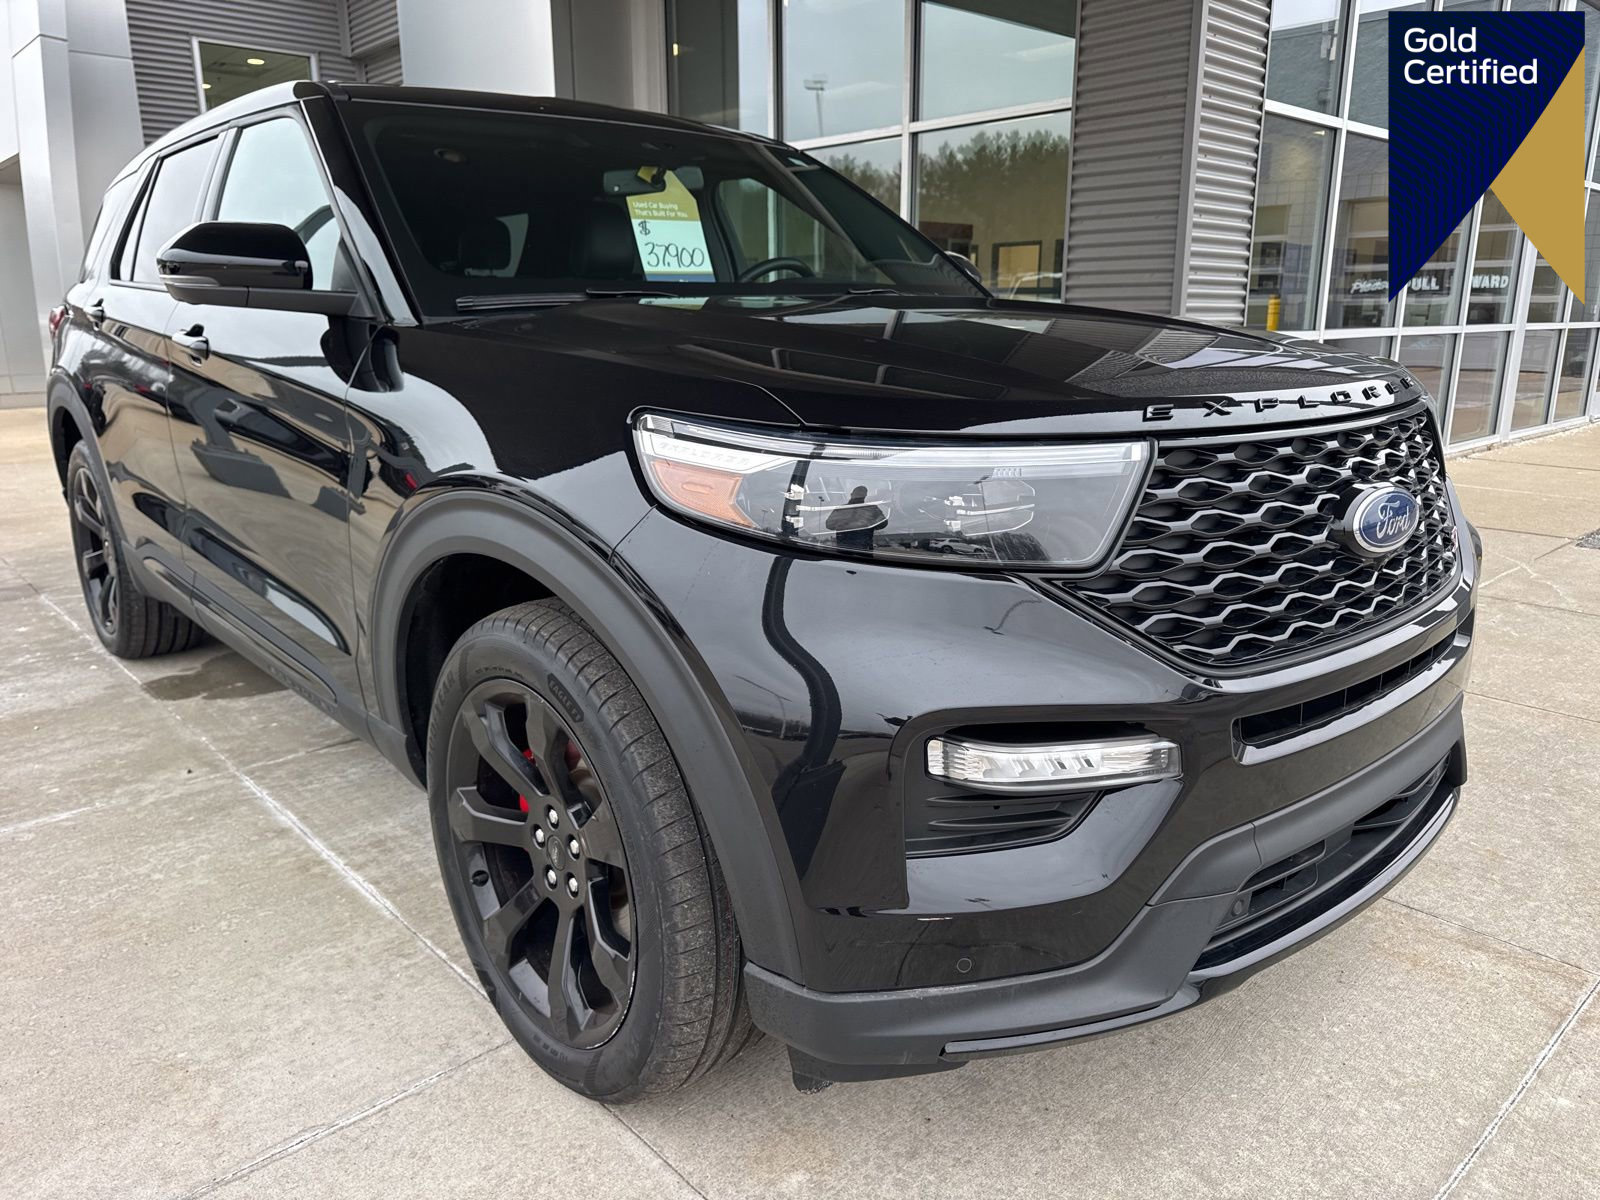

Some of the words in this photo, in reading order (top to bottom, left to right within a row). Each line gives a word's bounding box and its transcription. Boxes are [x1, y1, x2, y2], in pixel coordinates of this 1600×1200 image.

[659, 202, 678, 210] Buying
[638, 220, 651, 236] $
[1472, 274, 1509, 289] WARD
[1142, 376, 1414, 422] EXPLORER
[1376, 500, 1412, 539] Ford
